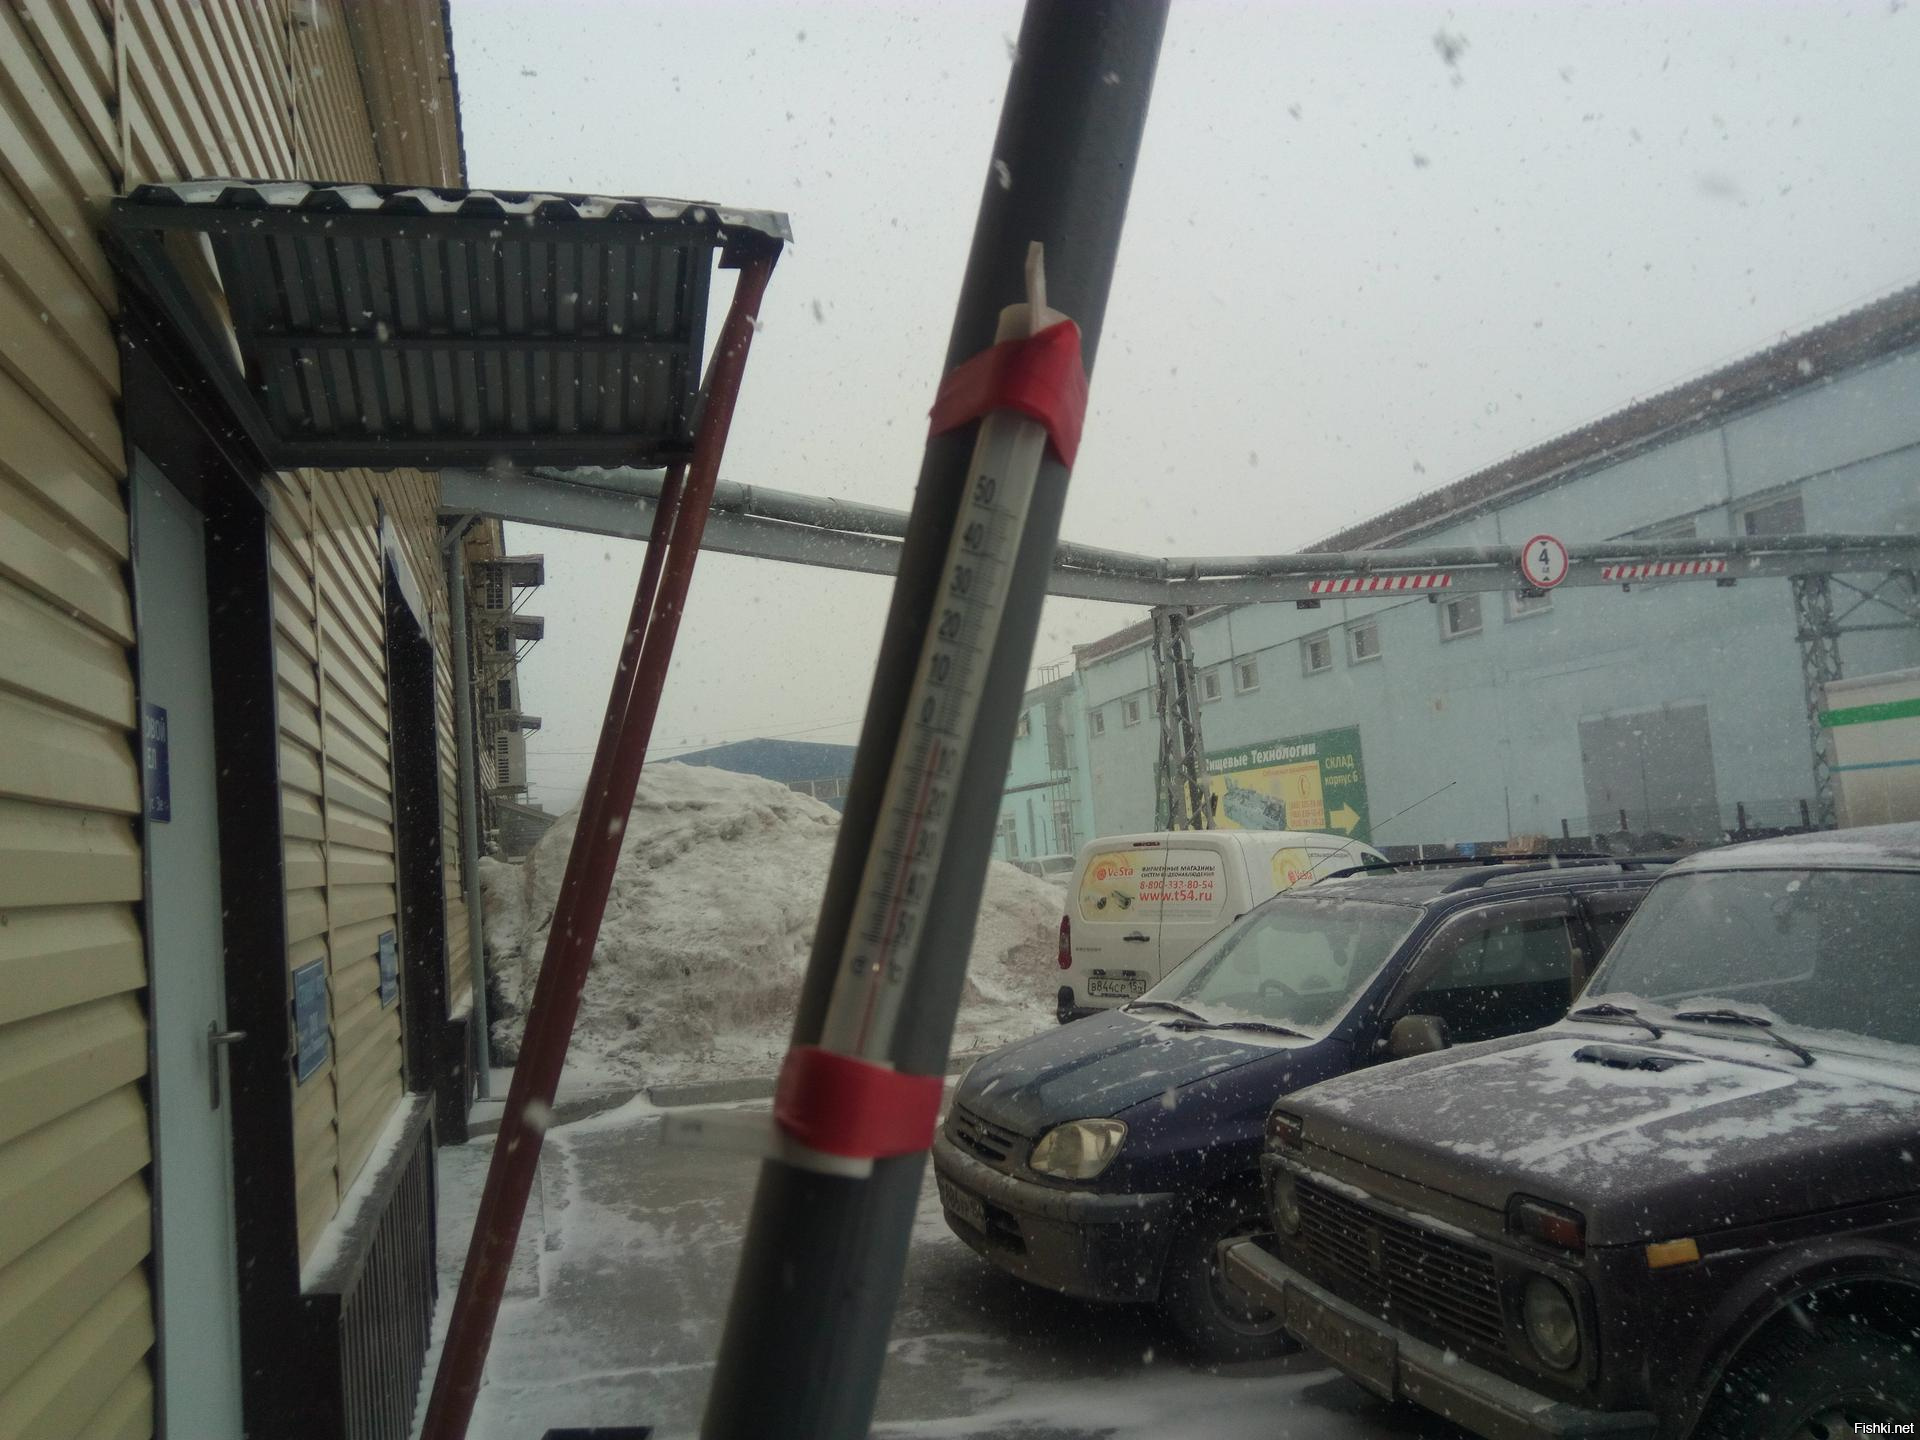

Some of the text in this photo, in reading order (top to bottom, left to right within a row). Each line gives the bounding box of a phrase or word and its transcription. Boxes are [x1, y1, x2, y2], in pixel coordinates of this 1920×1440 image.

[1538, 548, 1550, 565] 4
[938, 608, 961, 637] 20
[930, 652, 951, 682] 10
[1251, 742, 1316, 764] Технологии
[1325, 754, 1355, 770] СКЛАД
[1352, 770, 1359, 783] 6
[1140, 880, 1213, 889] 8-800-333-80-54
[1139, 890, 1212, 901] www.t54.ru
